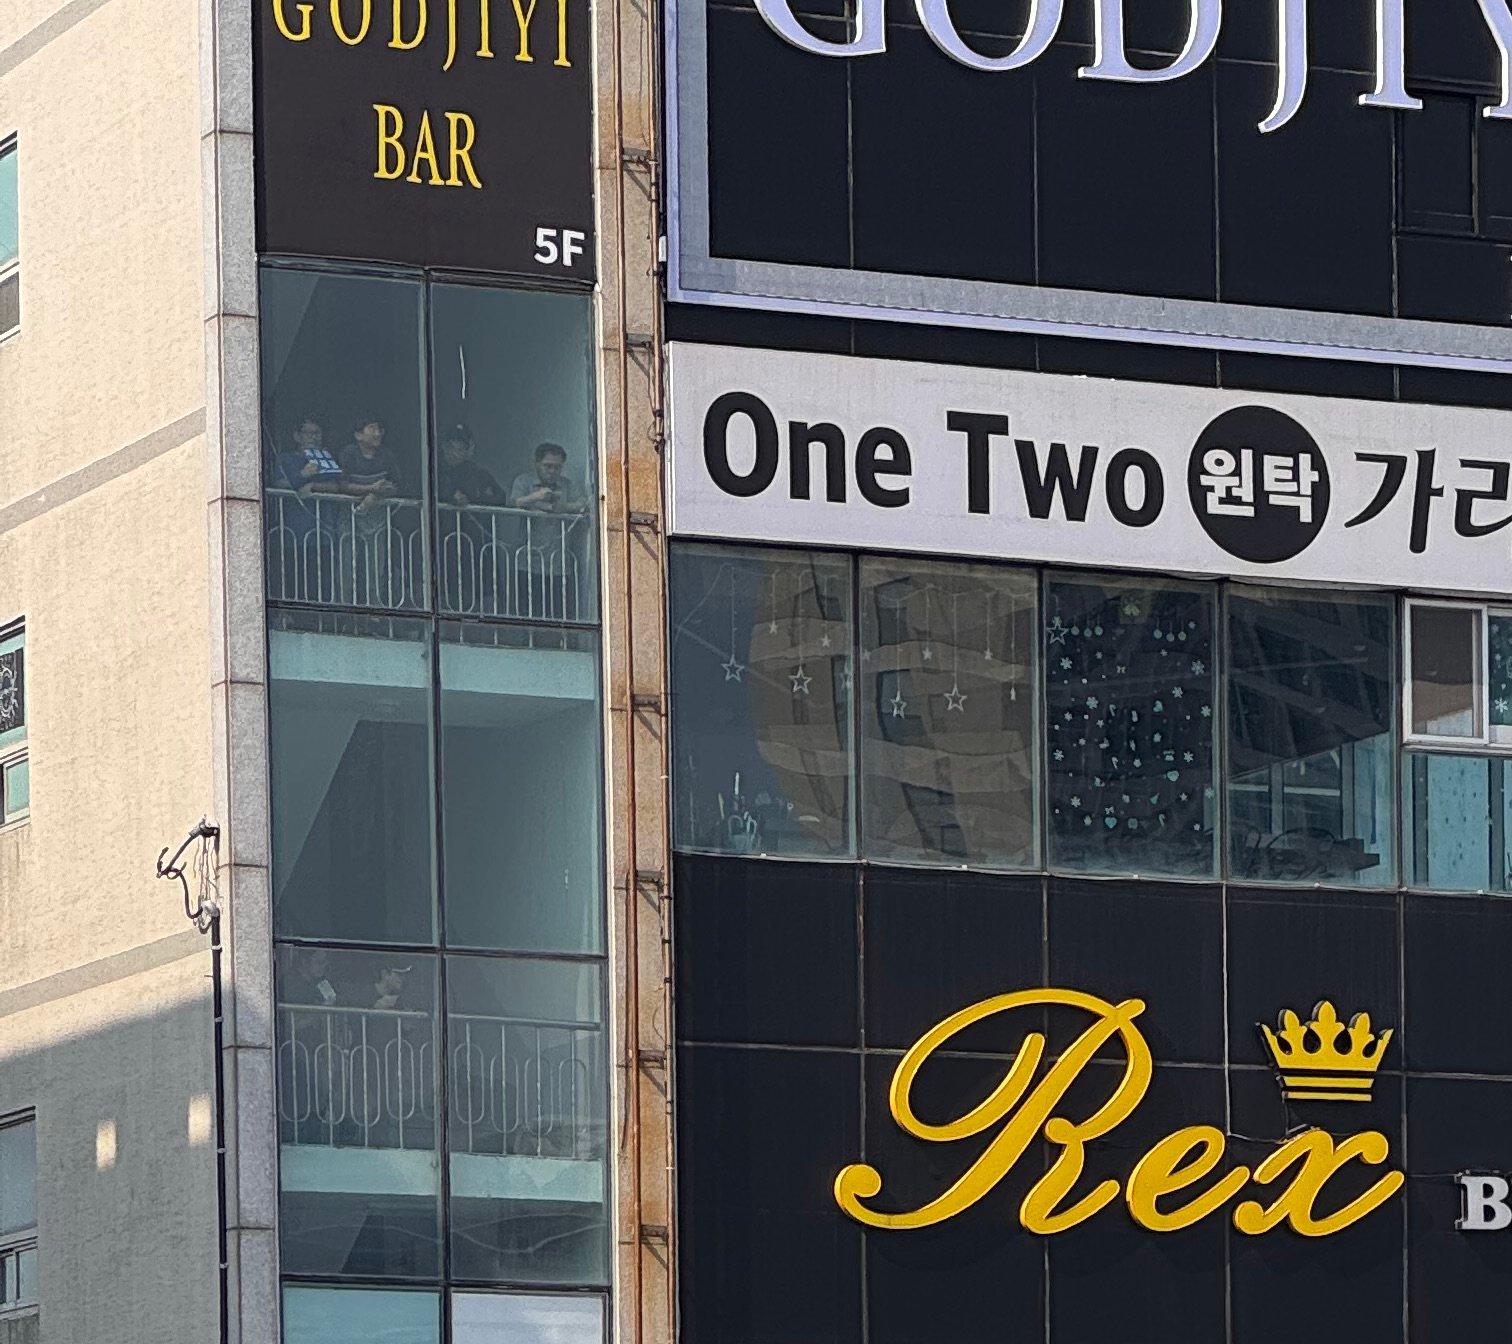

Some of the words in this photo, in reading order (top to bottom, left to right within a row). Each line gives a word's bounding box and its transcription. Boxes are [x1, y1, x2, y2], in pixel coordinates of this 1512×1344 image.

[372, 104, 482, 189] BAR
[534, 228, 586, 266] 5F
[703, 391, 913, 507] One
[946, 410, 1165, 528] Two
[1200, 448, 1314, 523] 원탁
[834, 987, 1405, 1236] Rex
